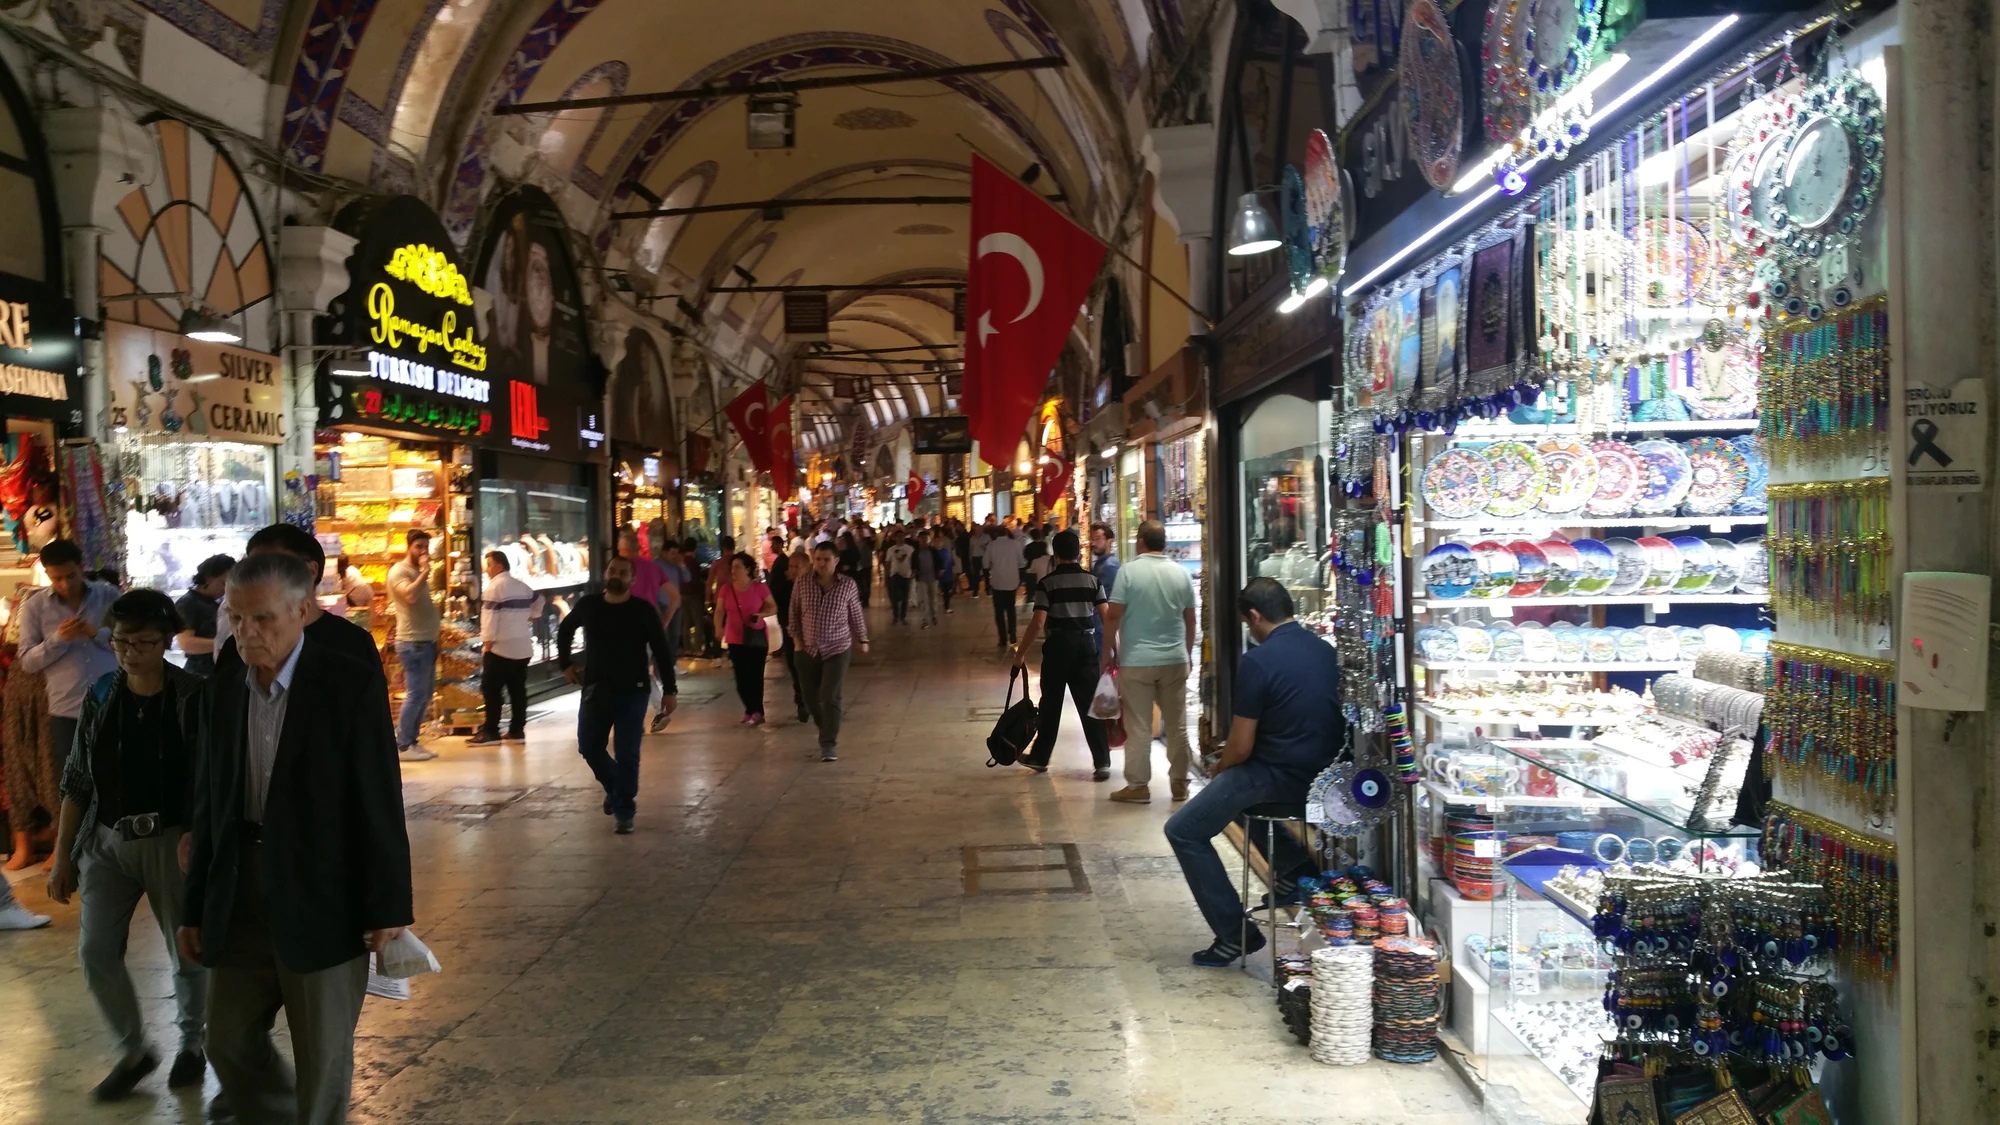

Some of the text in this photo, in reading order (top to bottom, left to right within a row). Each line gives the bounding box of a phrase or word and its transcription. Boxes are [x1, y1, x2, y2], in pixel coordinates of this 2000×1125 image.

[220, 352, 274, 386] SILVER
[368, 350, 435, 391] TURKISH
[436, 369, 490, 403] DELIGHT
[242, 387, 253, 404] &
[210, 403, 286, 437] CERAMIC
